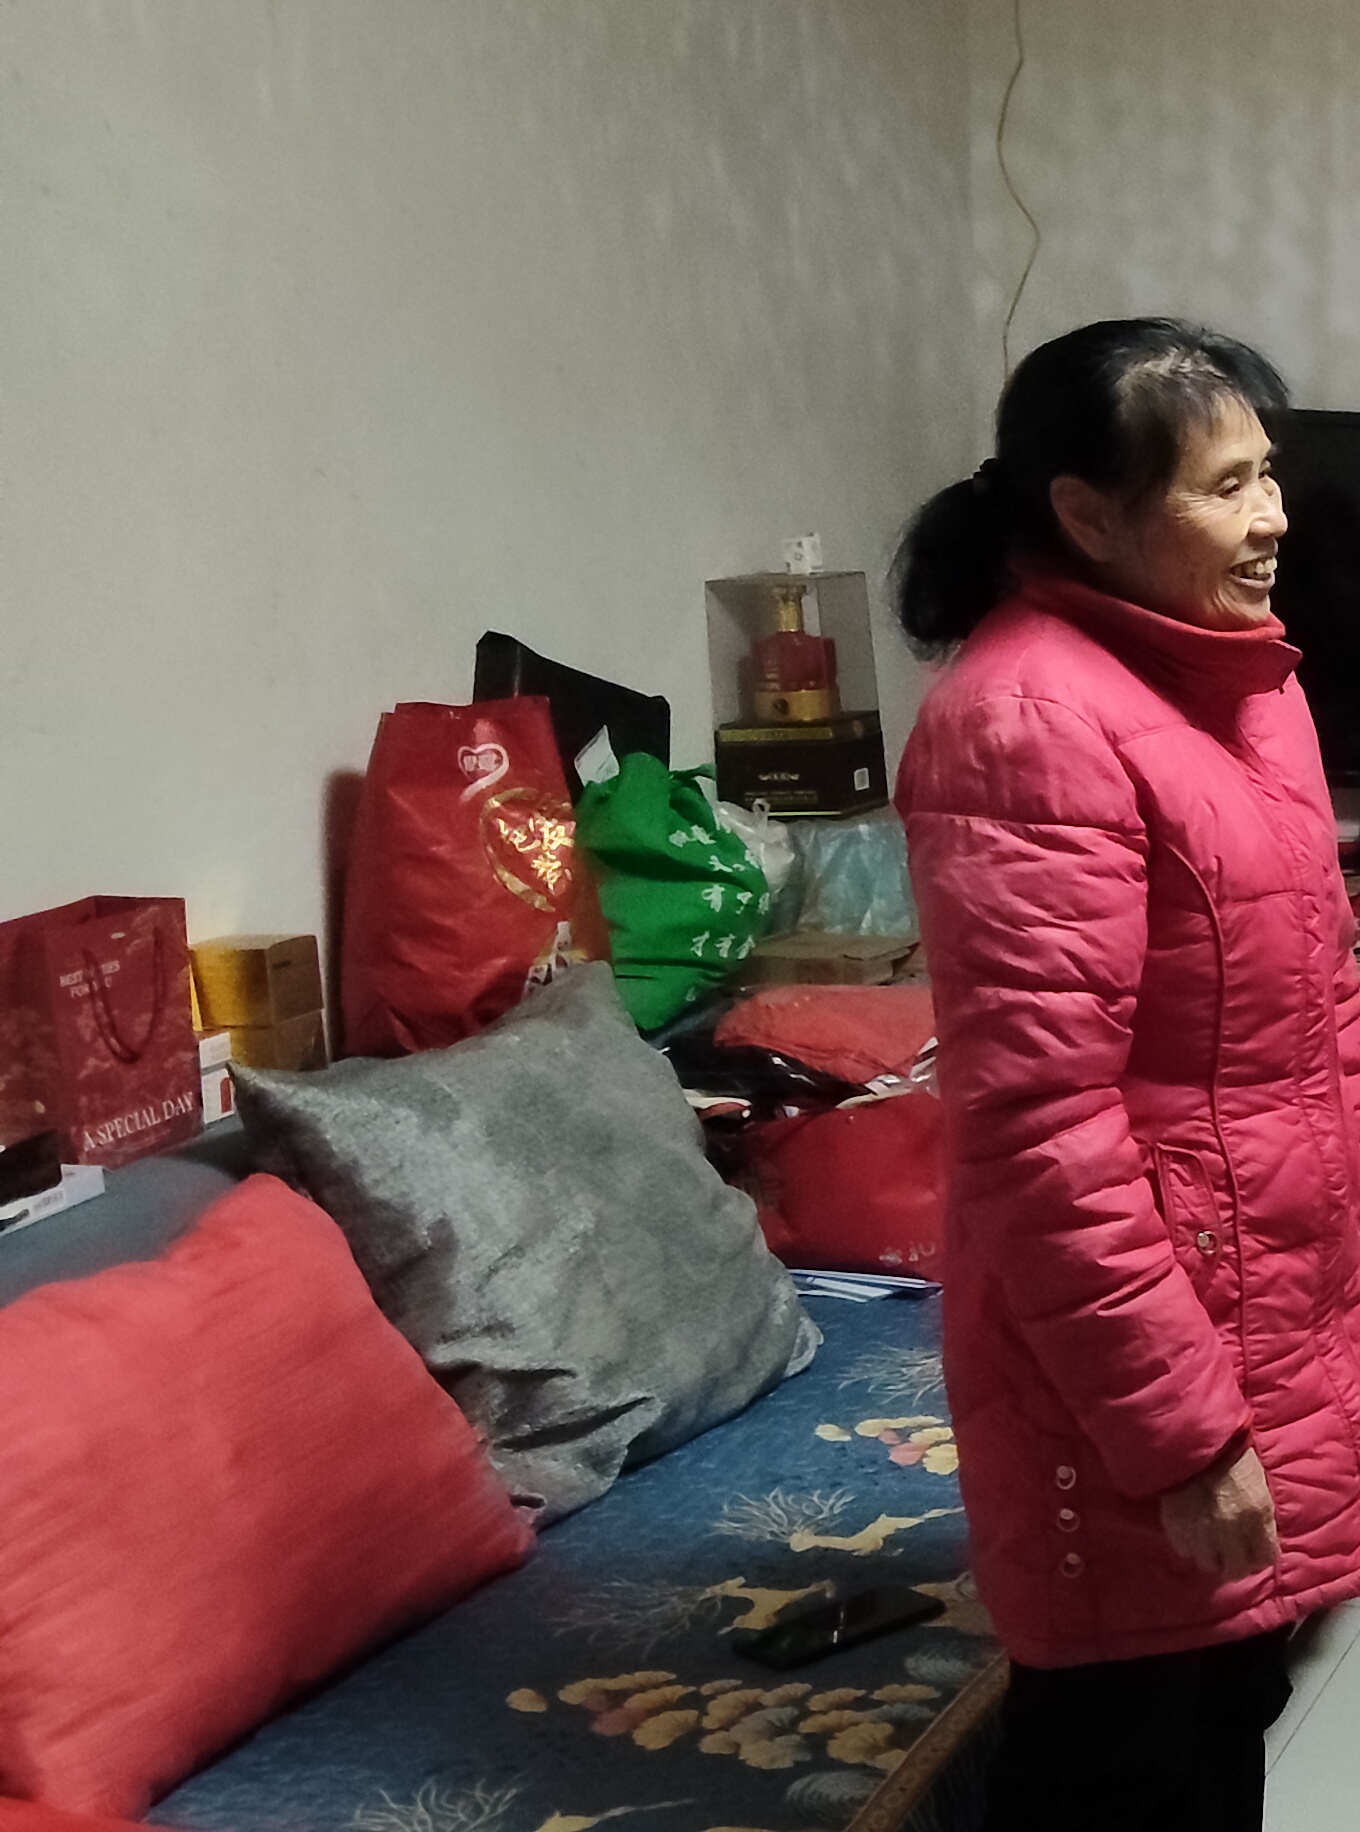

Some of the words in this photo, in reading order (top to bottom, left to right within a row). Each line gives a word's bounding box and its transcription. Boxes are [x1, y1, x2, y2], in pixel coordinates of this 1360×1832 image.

[82, 1130, 96, 1152] A
[97, 1106, 161, 1148] SPECIAL
[161, 1091, 195, 1122] DAY
